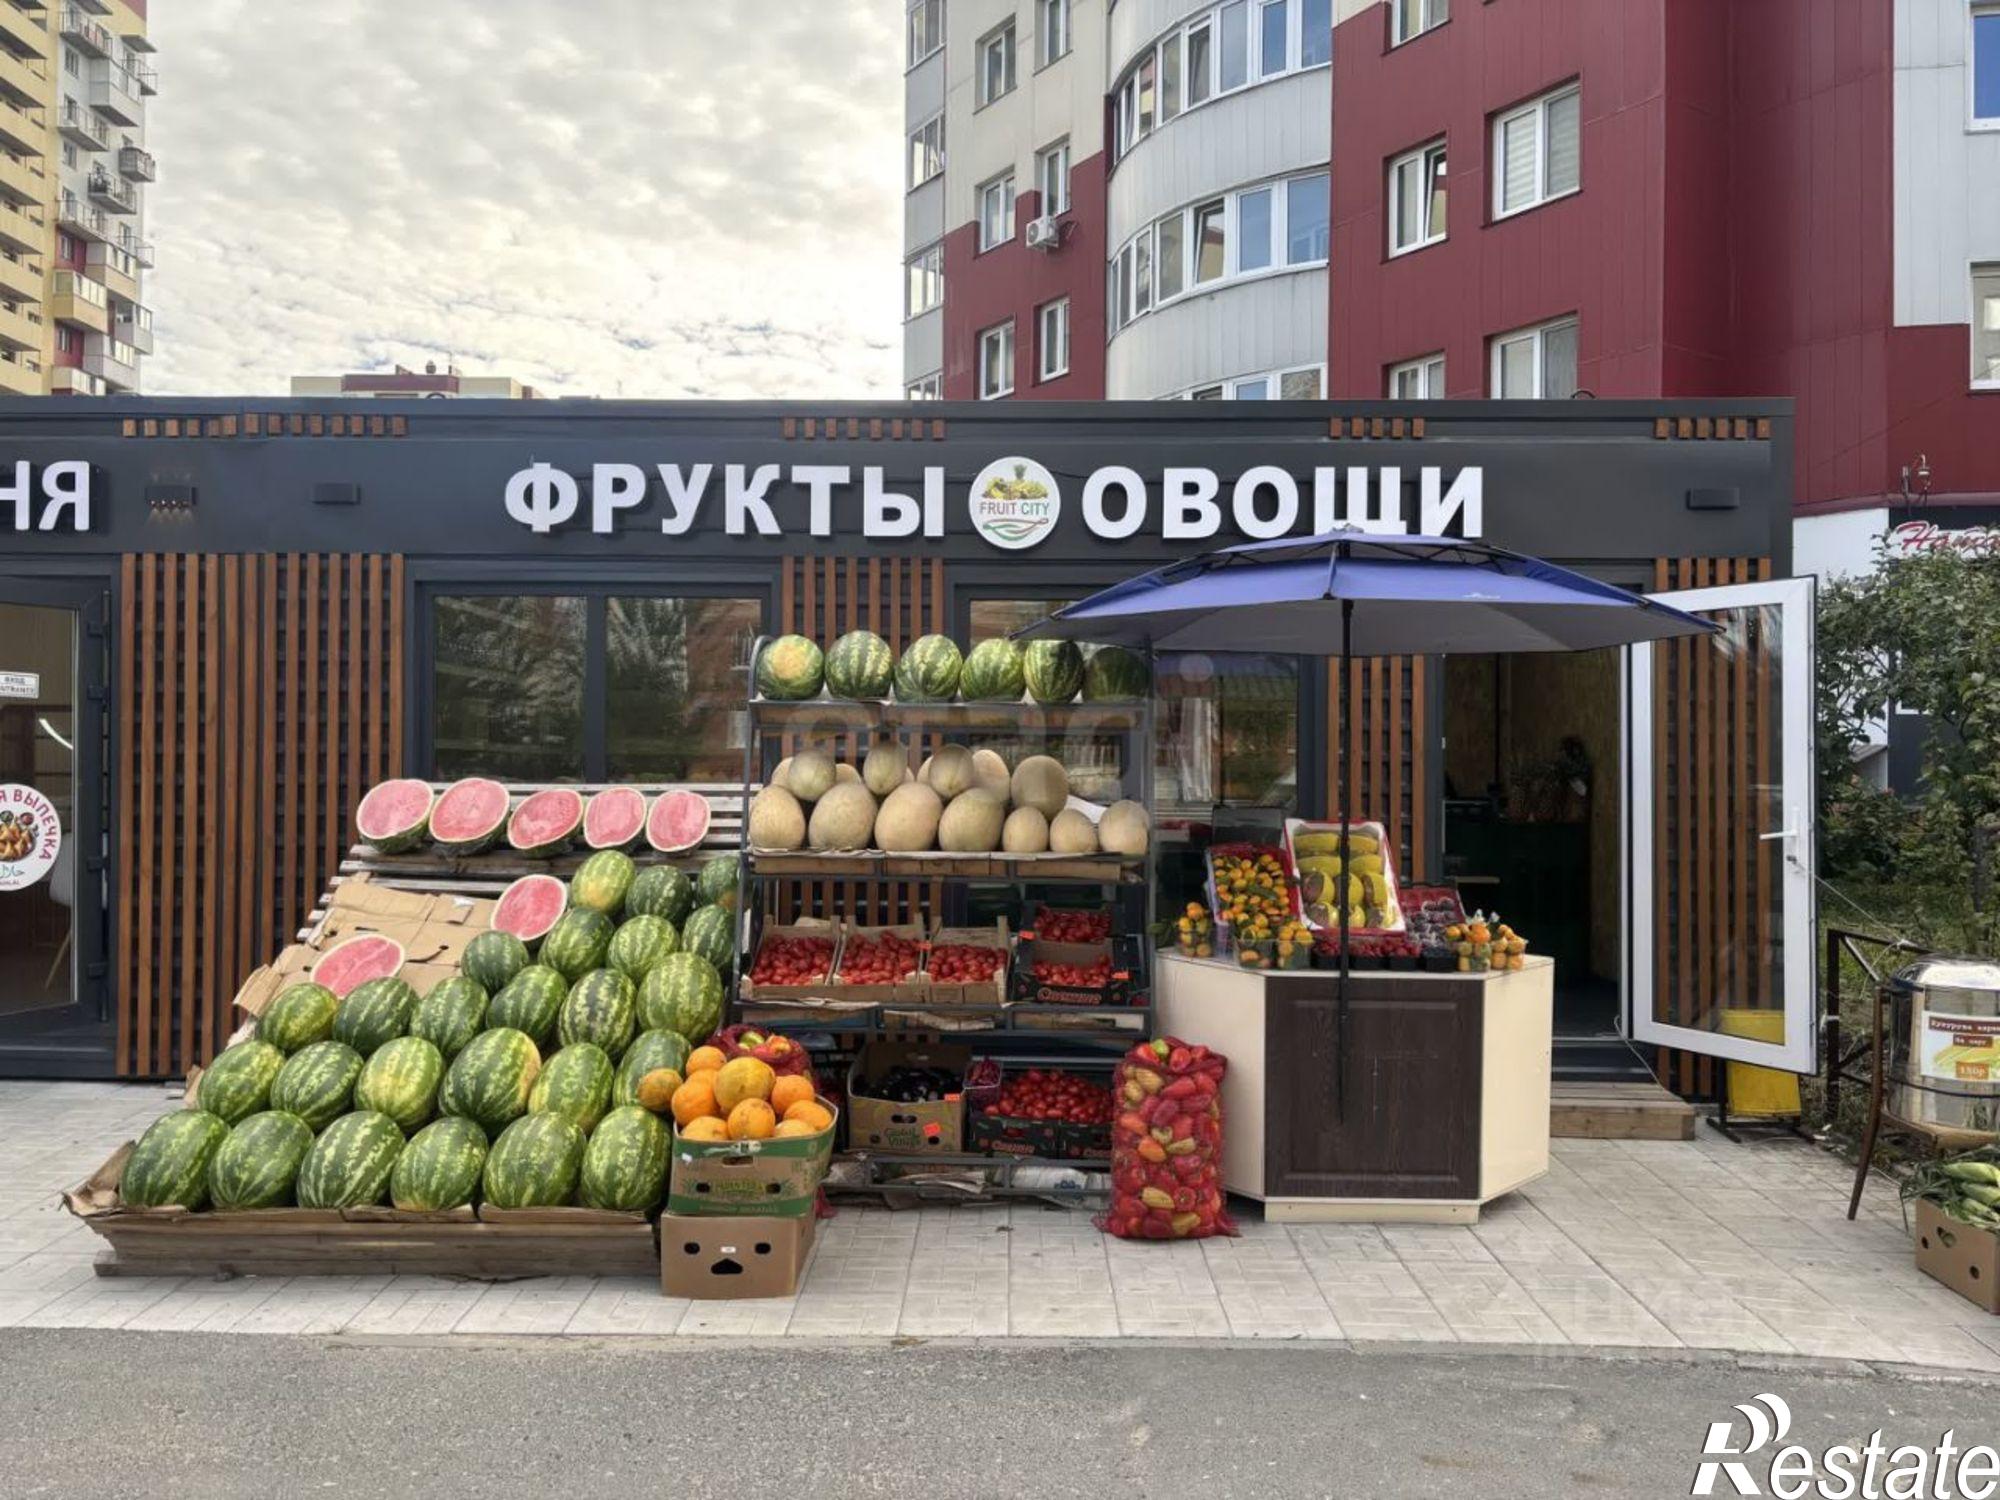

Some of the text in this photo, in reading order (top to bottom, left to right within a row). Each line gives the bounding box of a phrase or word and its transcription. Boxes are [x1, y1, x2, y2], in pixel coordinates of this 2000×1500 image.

[504, 462, 1483, 540] ФРУКТЫ ОВОЩИ
[979, 502, 1049, 515] FRUIT CITY
[13, 788, 57, 861] ВЫПЕЧКА
